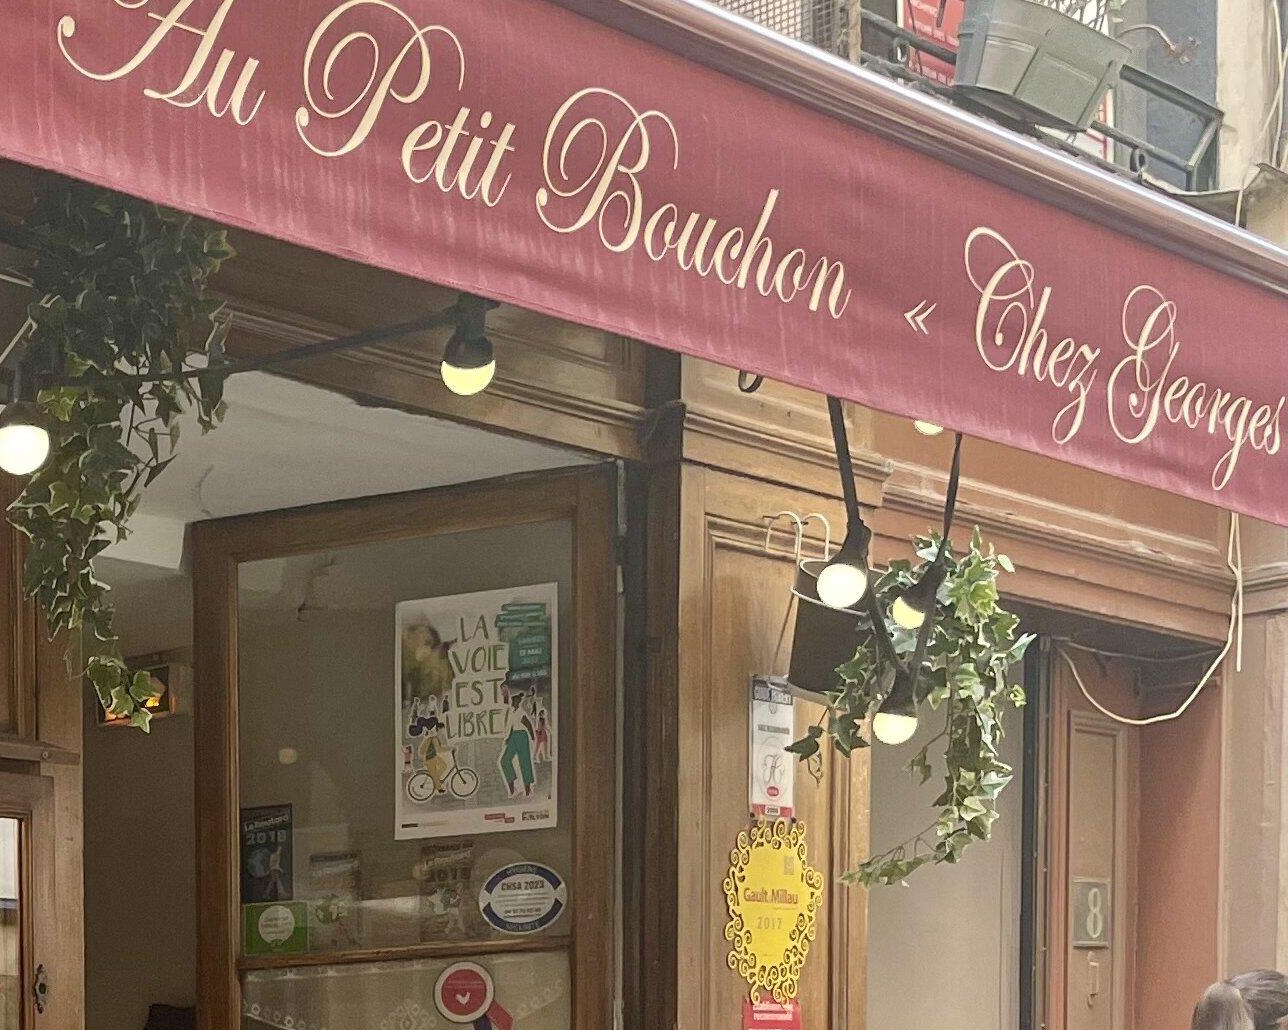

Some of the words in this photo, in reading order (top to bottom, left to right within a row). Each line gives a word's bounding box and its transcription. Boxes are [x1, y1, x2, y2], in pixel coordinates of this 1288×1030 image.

[57, 0, 266, 126] Au
[295, 0, 515, 207] Petit
[536, 87, 851, 319] Bouchon
[964, 226, 1097, 445] Chez
[1107, 284, 1286, 491] Georges
[460, 614, 490, 642] LA
[452, 644, 507, 674] VOIE
[456, 678, 505, 708] EST
[1086, 887, 1103, 938] 8
